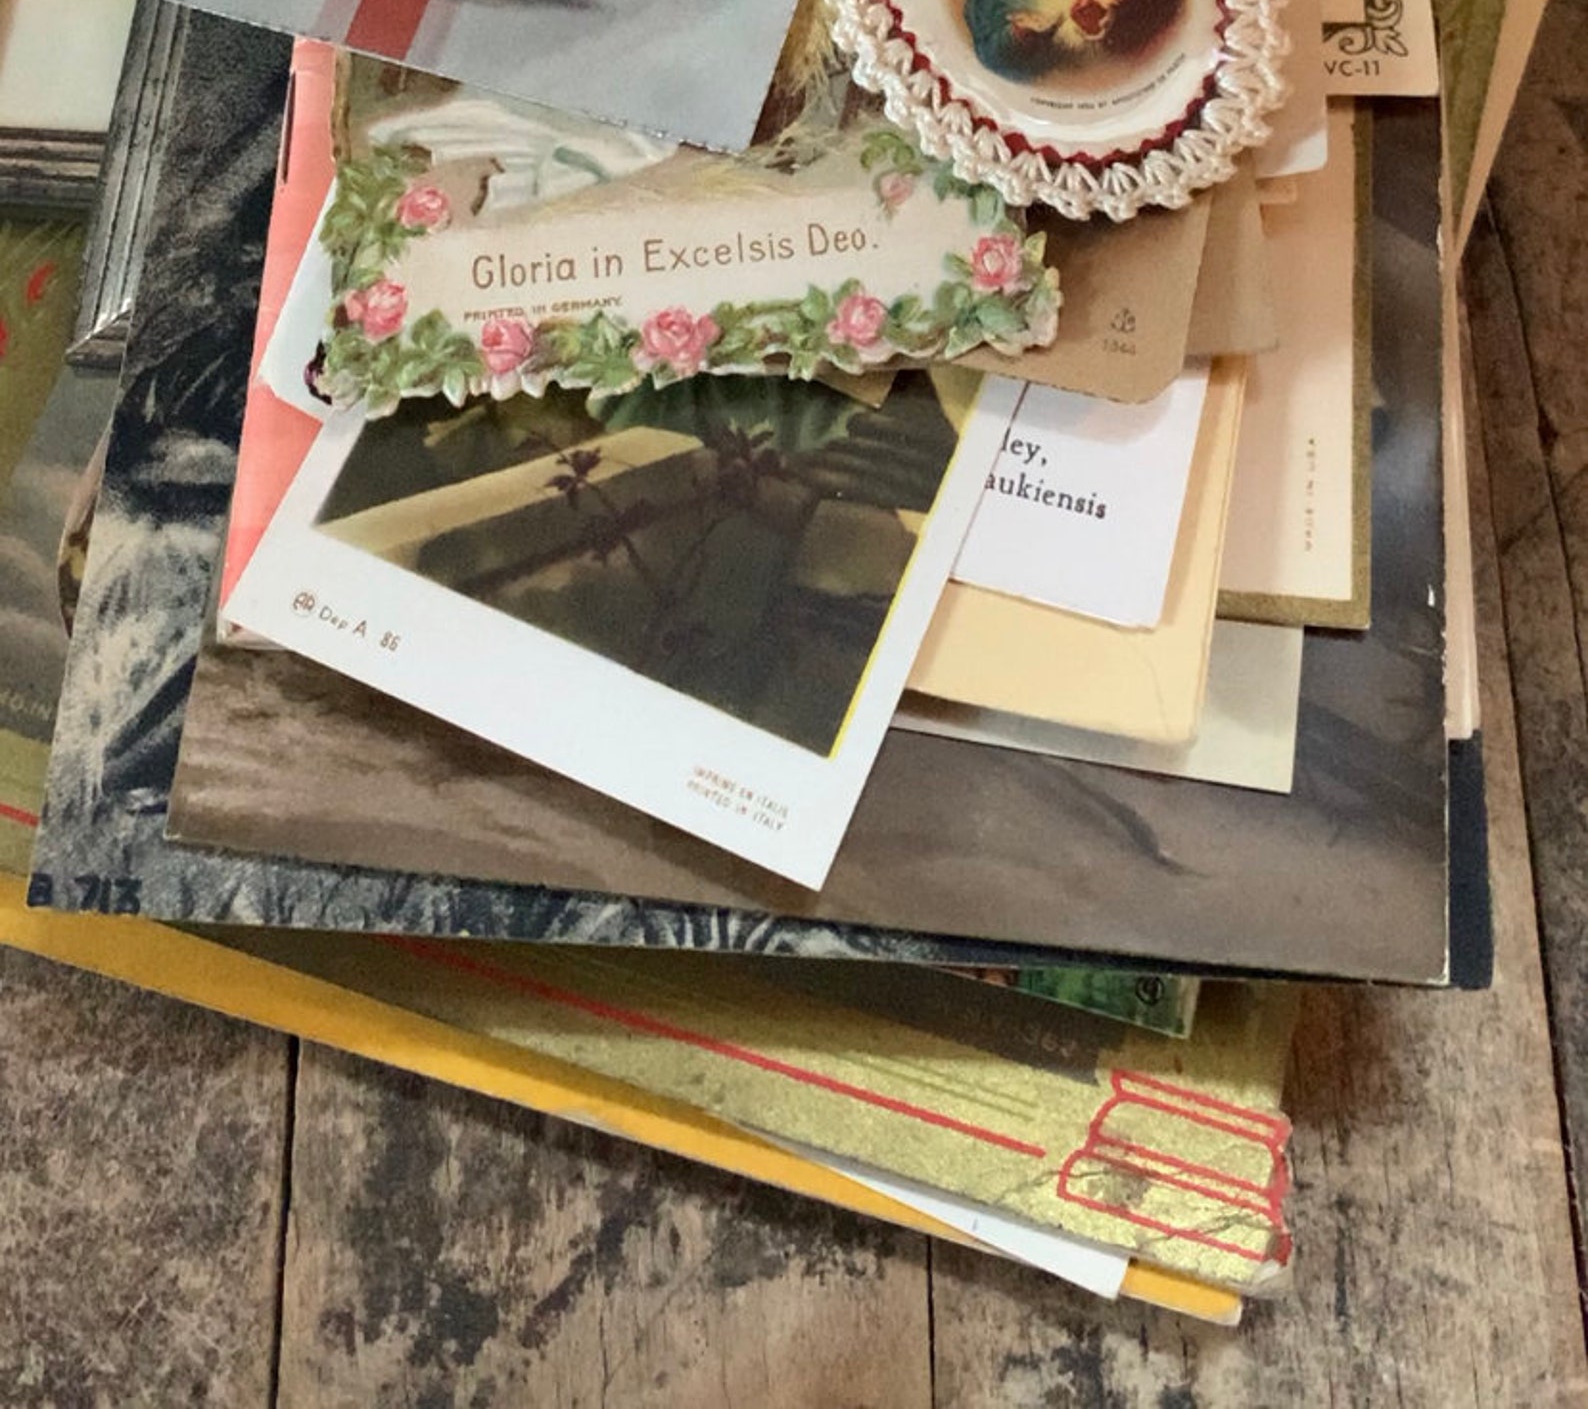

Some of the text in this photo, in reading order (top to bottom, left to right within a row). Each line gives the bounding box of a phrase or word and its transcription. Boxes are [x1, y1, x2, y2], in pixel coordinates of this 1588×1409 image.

[1323, 60, 1380, 77] VC-11
[472, 222, 879, 290] Gloria in Excelsis Deo.
[1001, 427, 1047, 466] ley,
[984, 472, 1107, 519] aukiensis
[353, 619, 367, 638] A
[380, 630, 401, 652] 86
[74, 874, 141, 915] 713
